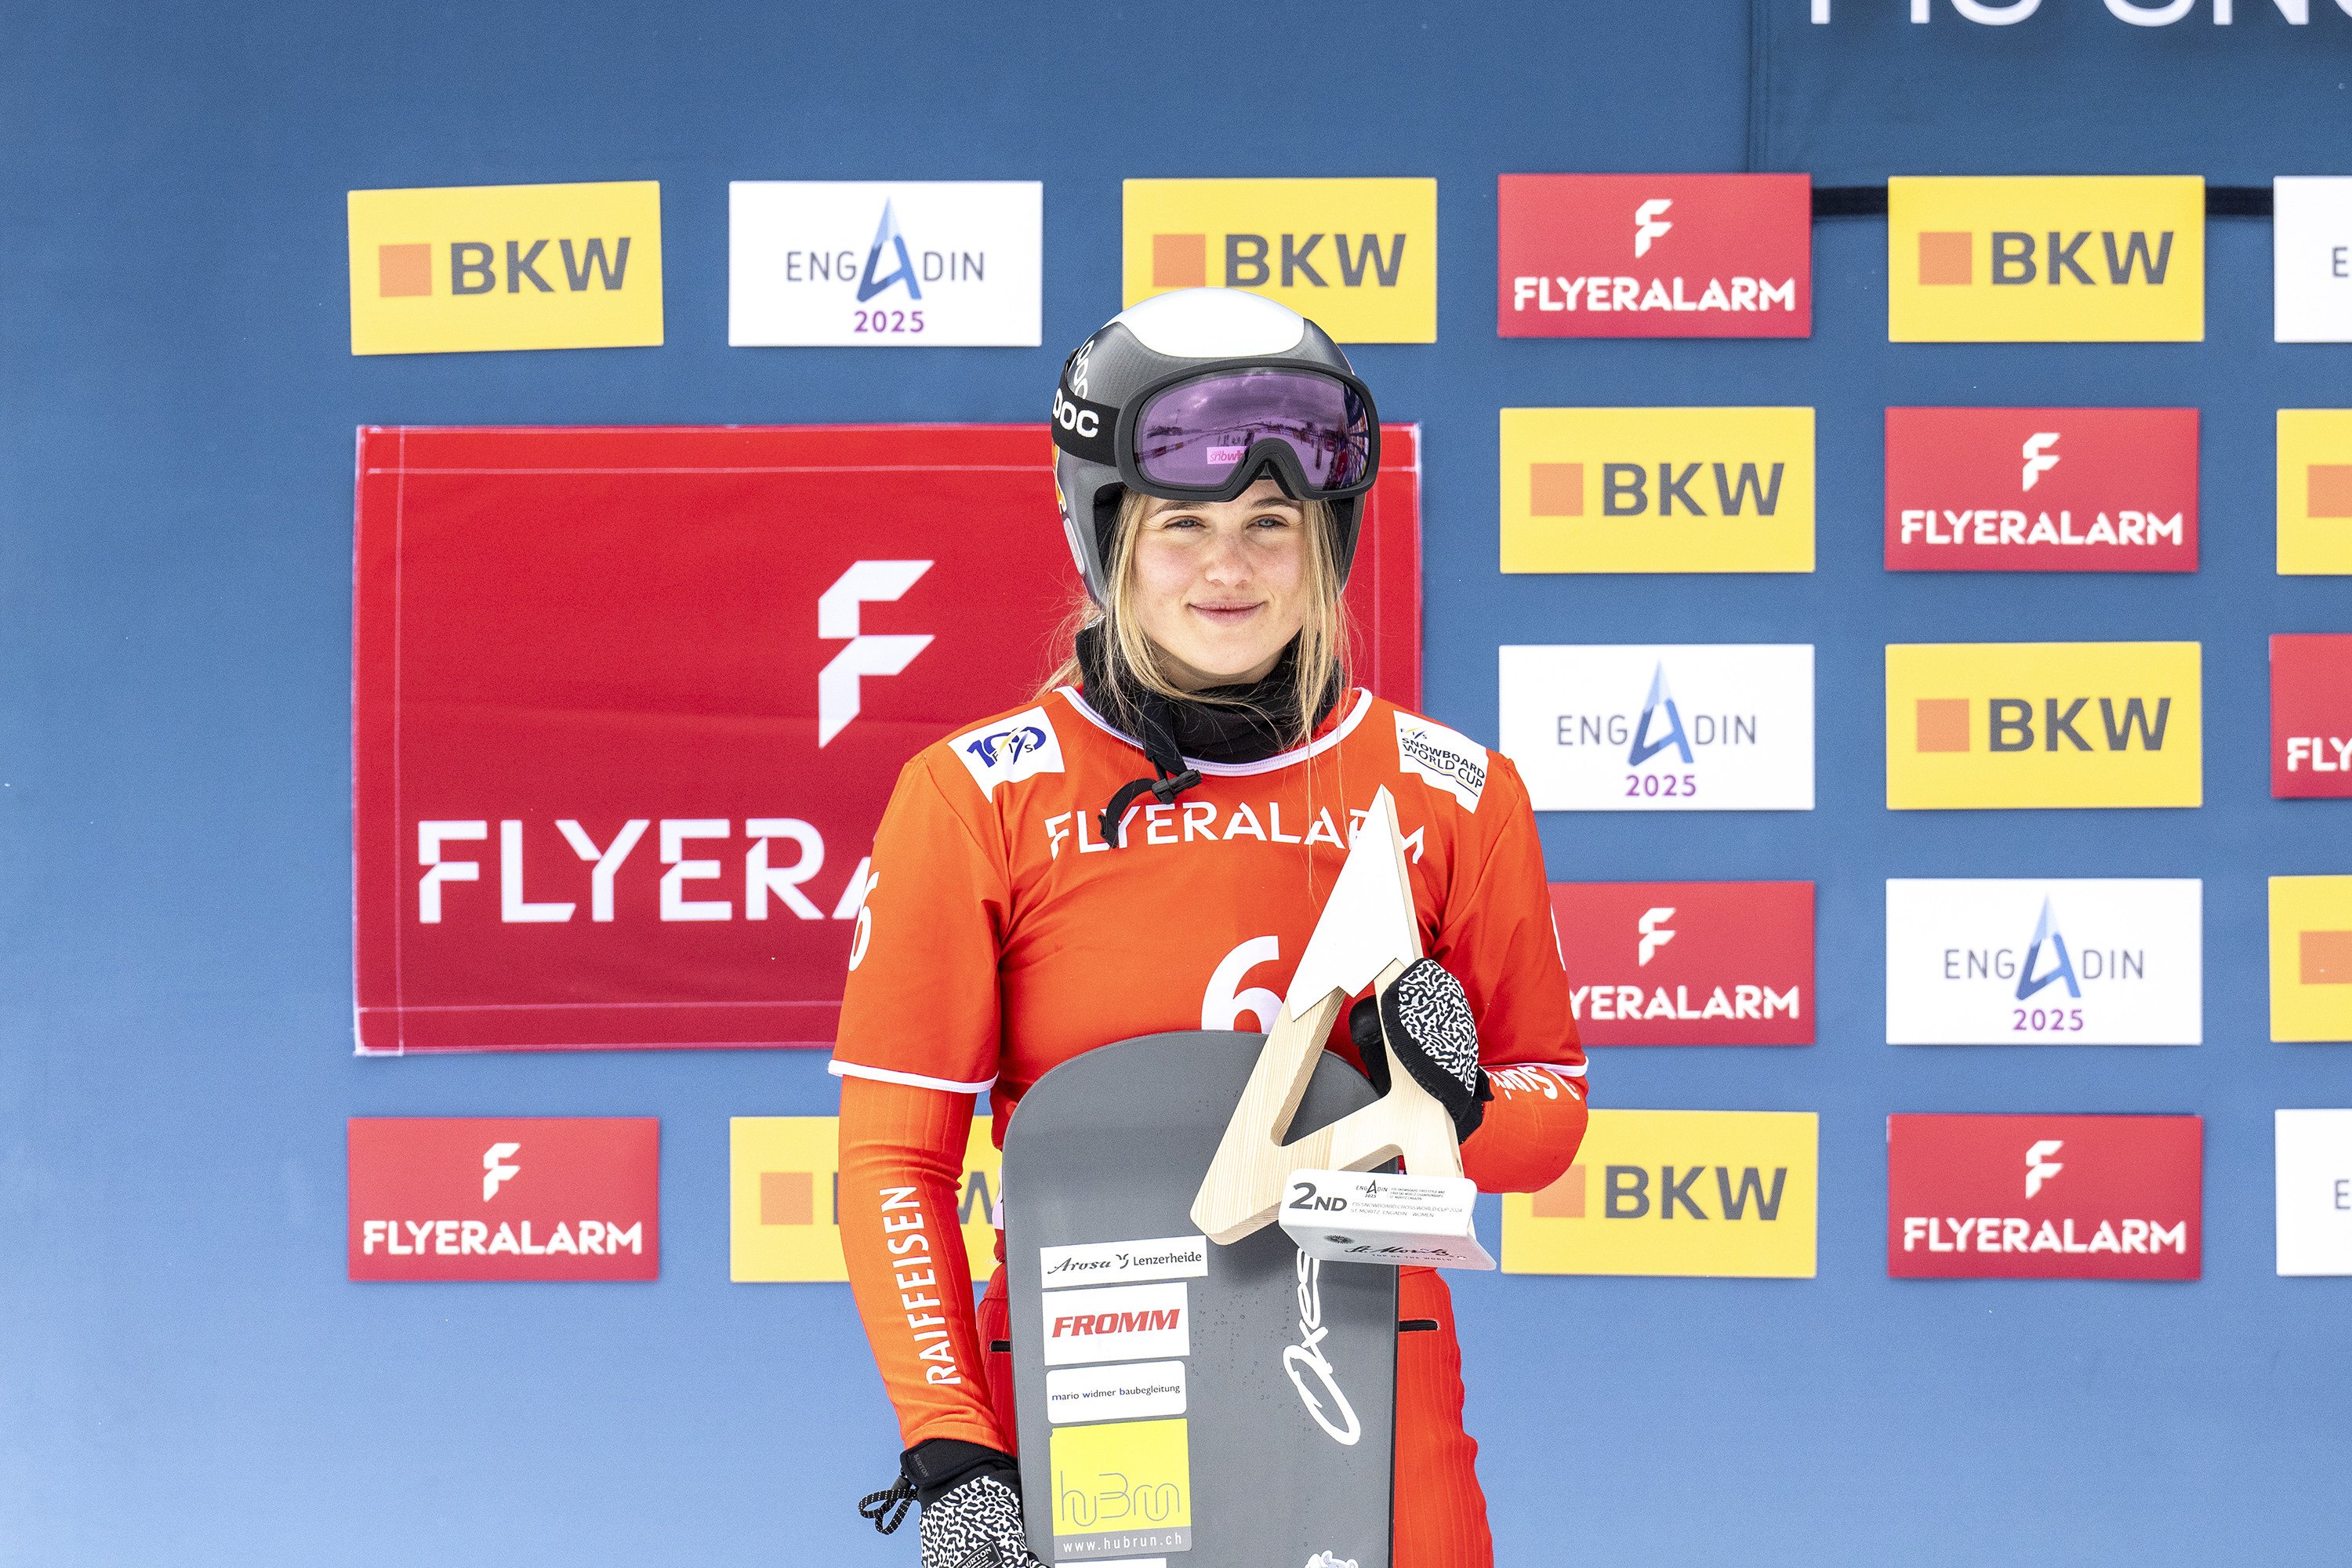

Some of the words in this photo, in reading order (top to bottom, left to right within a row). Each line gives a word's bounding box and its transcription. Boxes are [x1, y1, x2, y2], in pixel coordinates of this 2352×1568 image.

[450, 237, 632, 296] BKW
[1225, 233, 1407, 288] BKW
[1991, 230, 2175, 286] BKW
[1513, 276, 1795, 311] FLYERALARM
[854, 310, 925, 334] 2025
[1602, 462, 1786, 517] BKW
[1901, 510, 2183, 546] FLYERALARM
[1988, 697, 2172, 753] BKW
[1402, 738, 1486, 779] SNOWBOARD
[1403, 744, 1455, 770] WORLD
[1458, 768, 1483, 789] CUP
[1624, 774, 1697, 797] 2025
[418, 818, 872, 924] FLYER
[1202, 935, 1282, 1033] 6
[1570, 985, 1799, 1020] YERALARM
[2013, 1008, 2084, 1032] 2025
[1288, 1181, 1348, 1212] 2ND
[1356, 1179, 1388, 1193] ENGADIN
[1604, 1164, 1788, 1221] BKW
[363, 1220, 643, 1255] FLYERALARM
[1904, 1217, 2186, 1254] FLYERALARM
[1047, 1257, 1112, 1275] Arosa
[1133, 1251, 1202, 1266] Lenzerheide
[879, 1185, 961, 1385] RAIFFEISEN
[1052, 1308, 1180, 1338] FROMM
[1051, 1392, 1080, 1401] mario
[1083, 1389, 1116, 1399] widmer
[1119, 1385, 1181, 1396] baubegleitung
[1062, 1532, 1182, 1553] www.hubrun.ch
